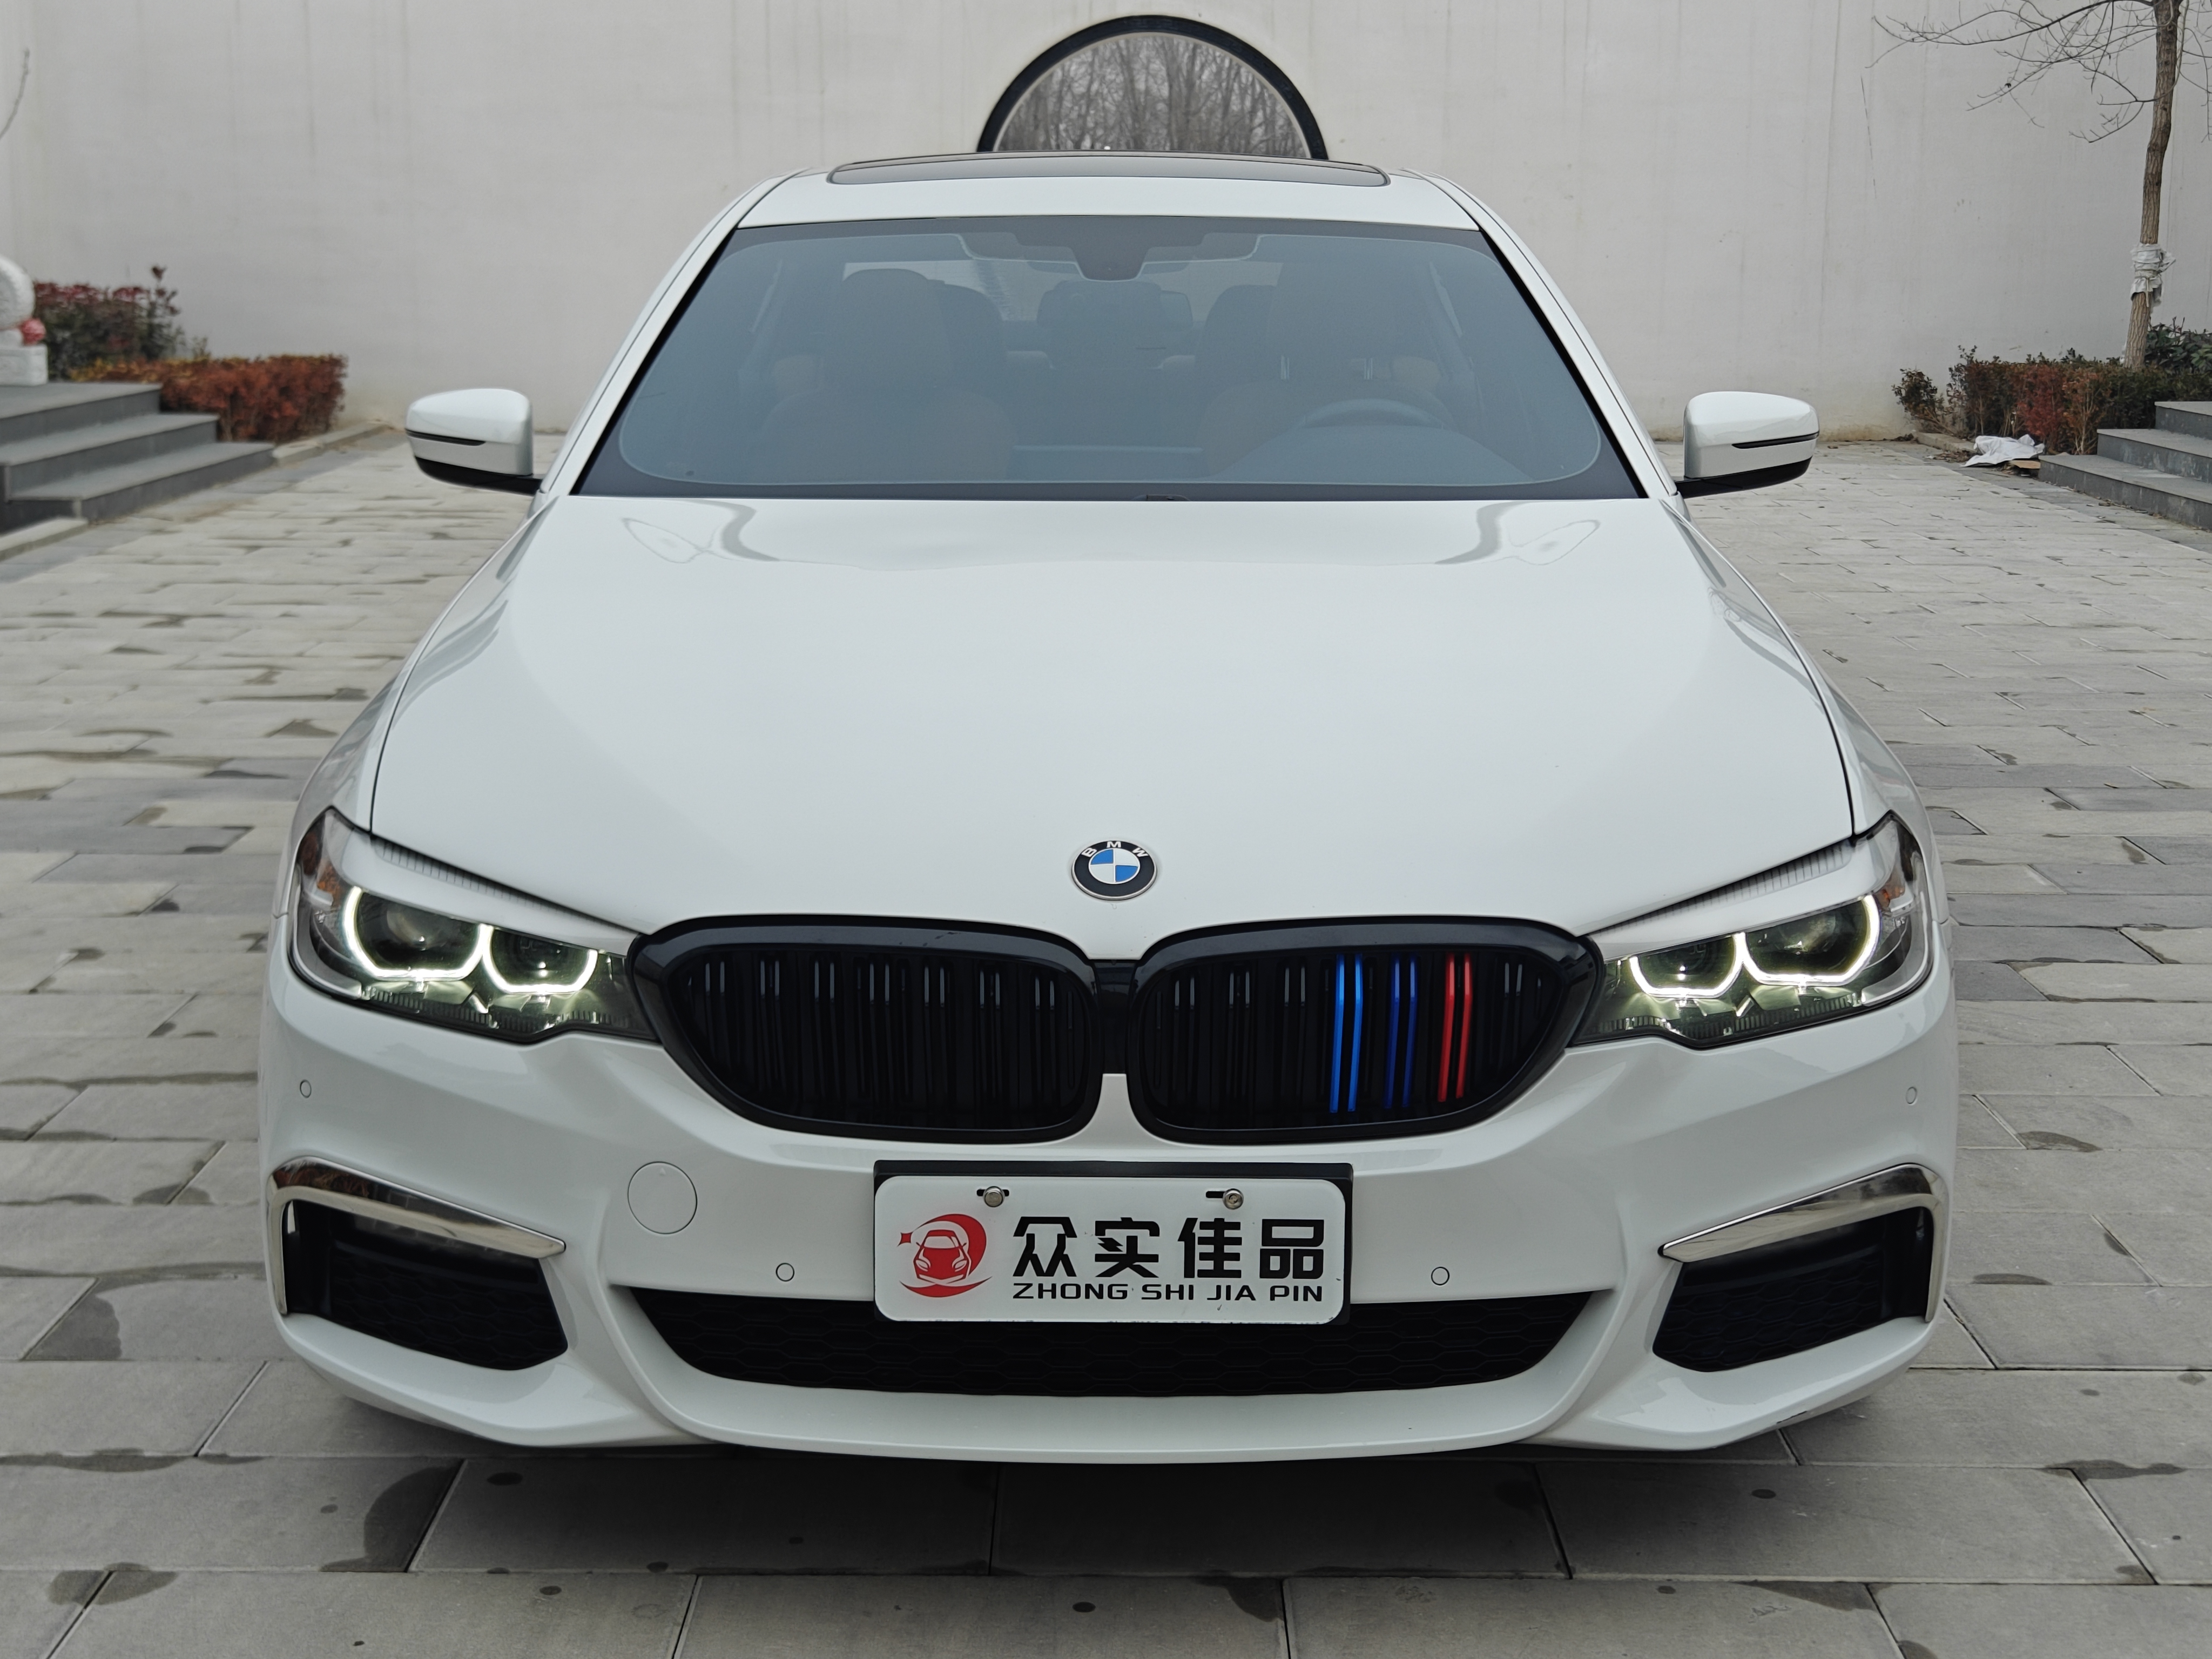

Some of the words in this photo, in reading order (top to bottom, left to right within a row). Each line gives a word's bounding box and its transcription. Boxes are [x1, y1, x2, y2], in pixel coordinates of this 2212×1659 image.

[1081, 841, 1149, 858] BMW
[1013, 1216, 1325, 1279] 众实佳品
[1013, 1283, 1129, 1300] ZHONG
[1141, 1284, 1194, 1301] SHI
[1206, 1284, 1256, 1301] JIA
[1270, 1285, 1323, 1302] PIN
